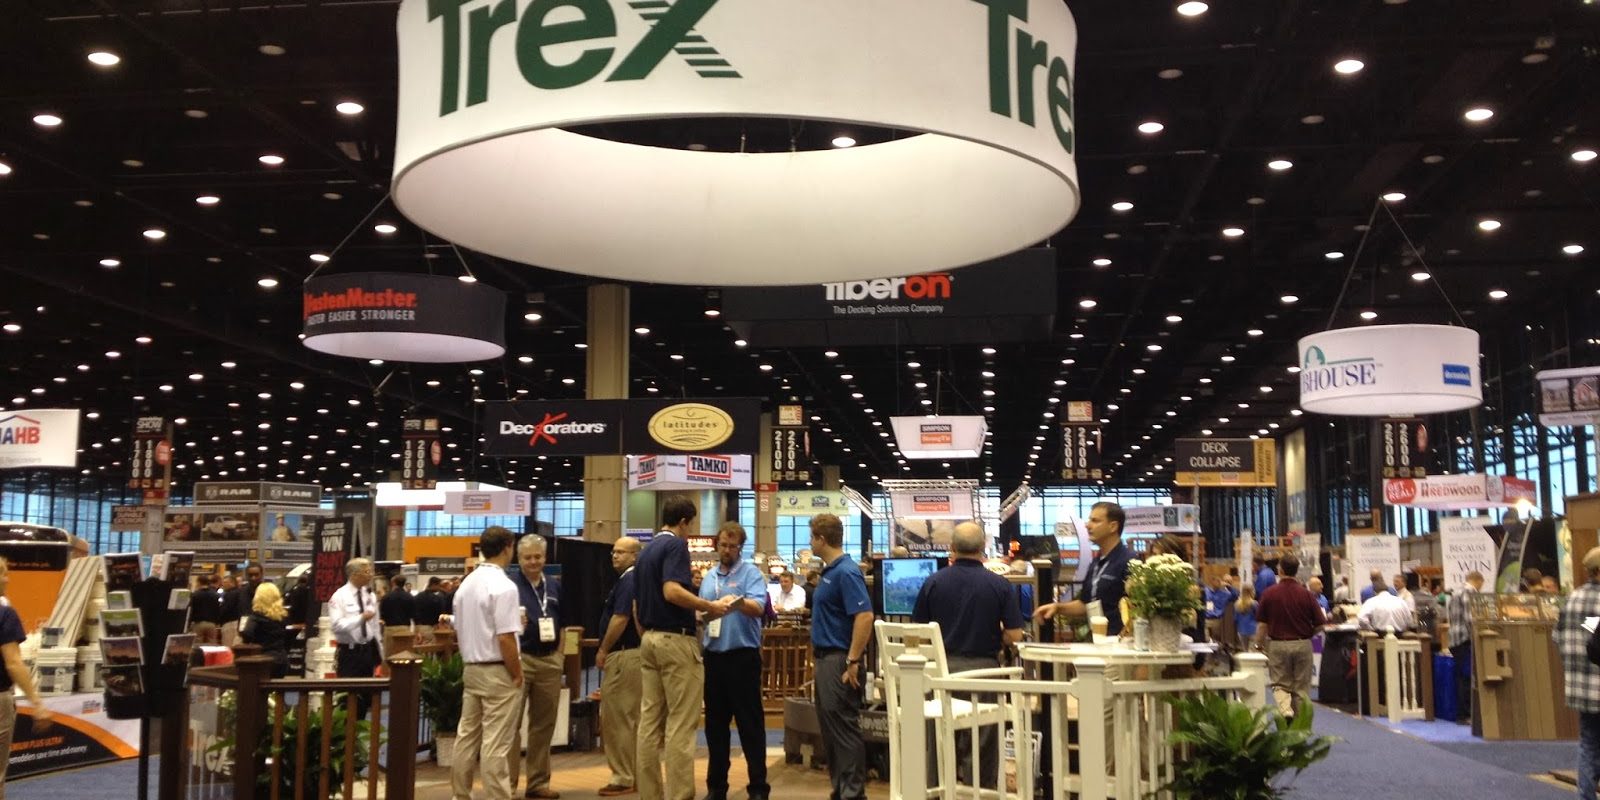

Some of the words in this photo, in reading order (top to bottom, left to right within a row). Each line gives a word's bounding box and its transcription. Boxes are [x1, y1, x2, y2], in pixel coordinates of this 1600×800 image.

[428, 0, 743, 117] Trex
[328, 311, 357, 322] EASIER
[361, 310, 415, 320] STRONGER
[833, 305, 846, 314] The
[847, 305, 875, 315] Decking
[877, 304, 909, 314] Solutions
[911, 303, 943, 314] Company
[0, 427, 40, 444] AHB
[1064, 427, 1073, 468] 2300
[1201, 442, 1229, 453] DECK
[132, 440, 140, 478] 1700
[144, 440, 152, 478] 1800
[403, 440, 412, 478] 1900
[416, 440, 425, 478] 2000
[774, 431, 782, 470] 2100
[788, 431, 796, 470] 2200
[1190, 456, 1240, 468] COLLAPSE
[690, 457, 728, 474] TAMKO
[322, 536, 343, 552] WIN
[1457, 560, 1491, 572] WIN
